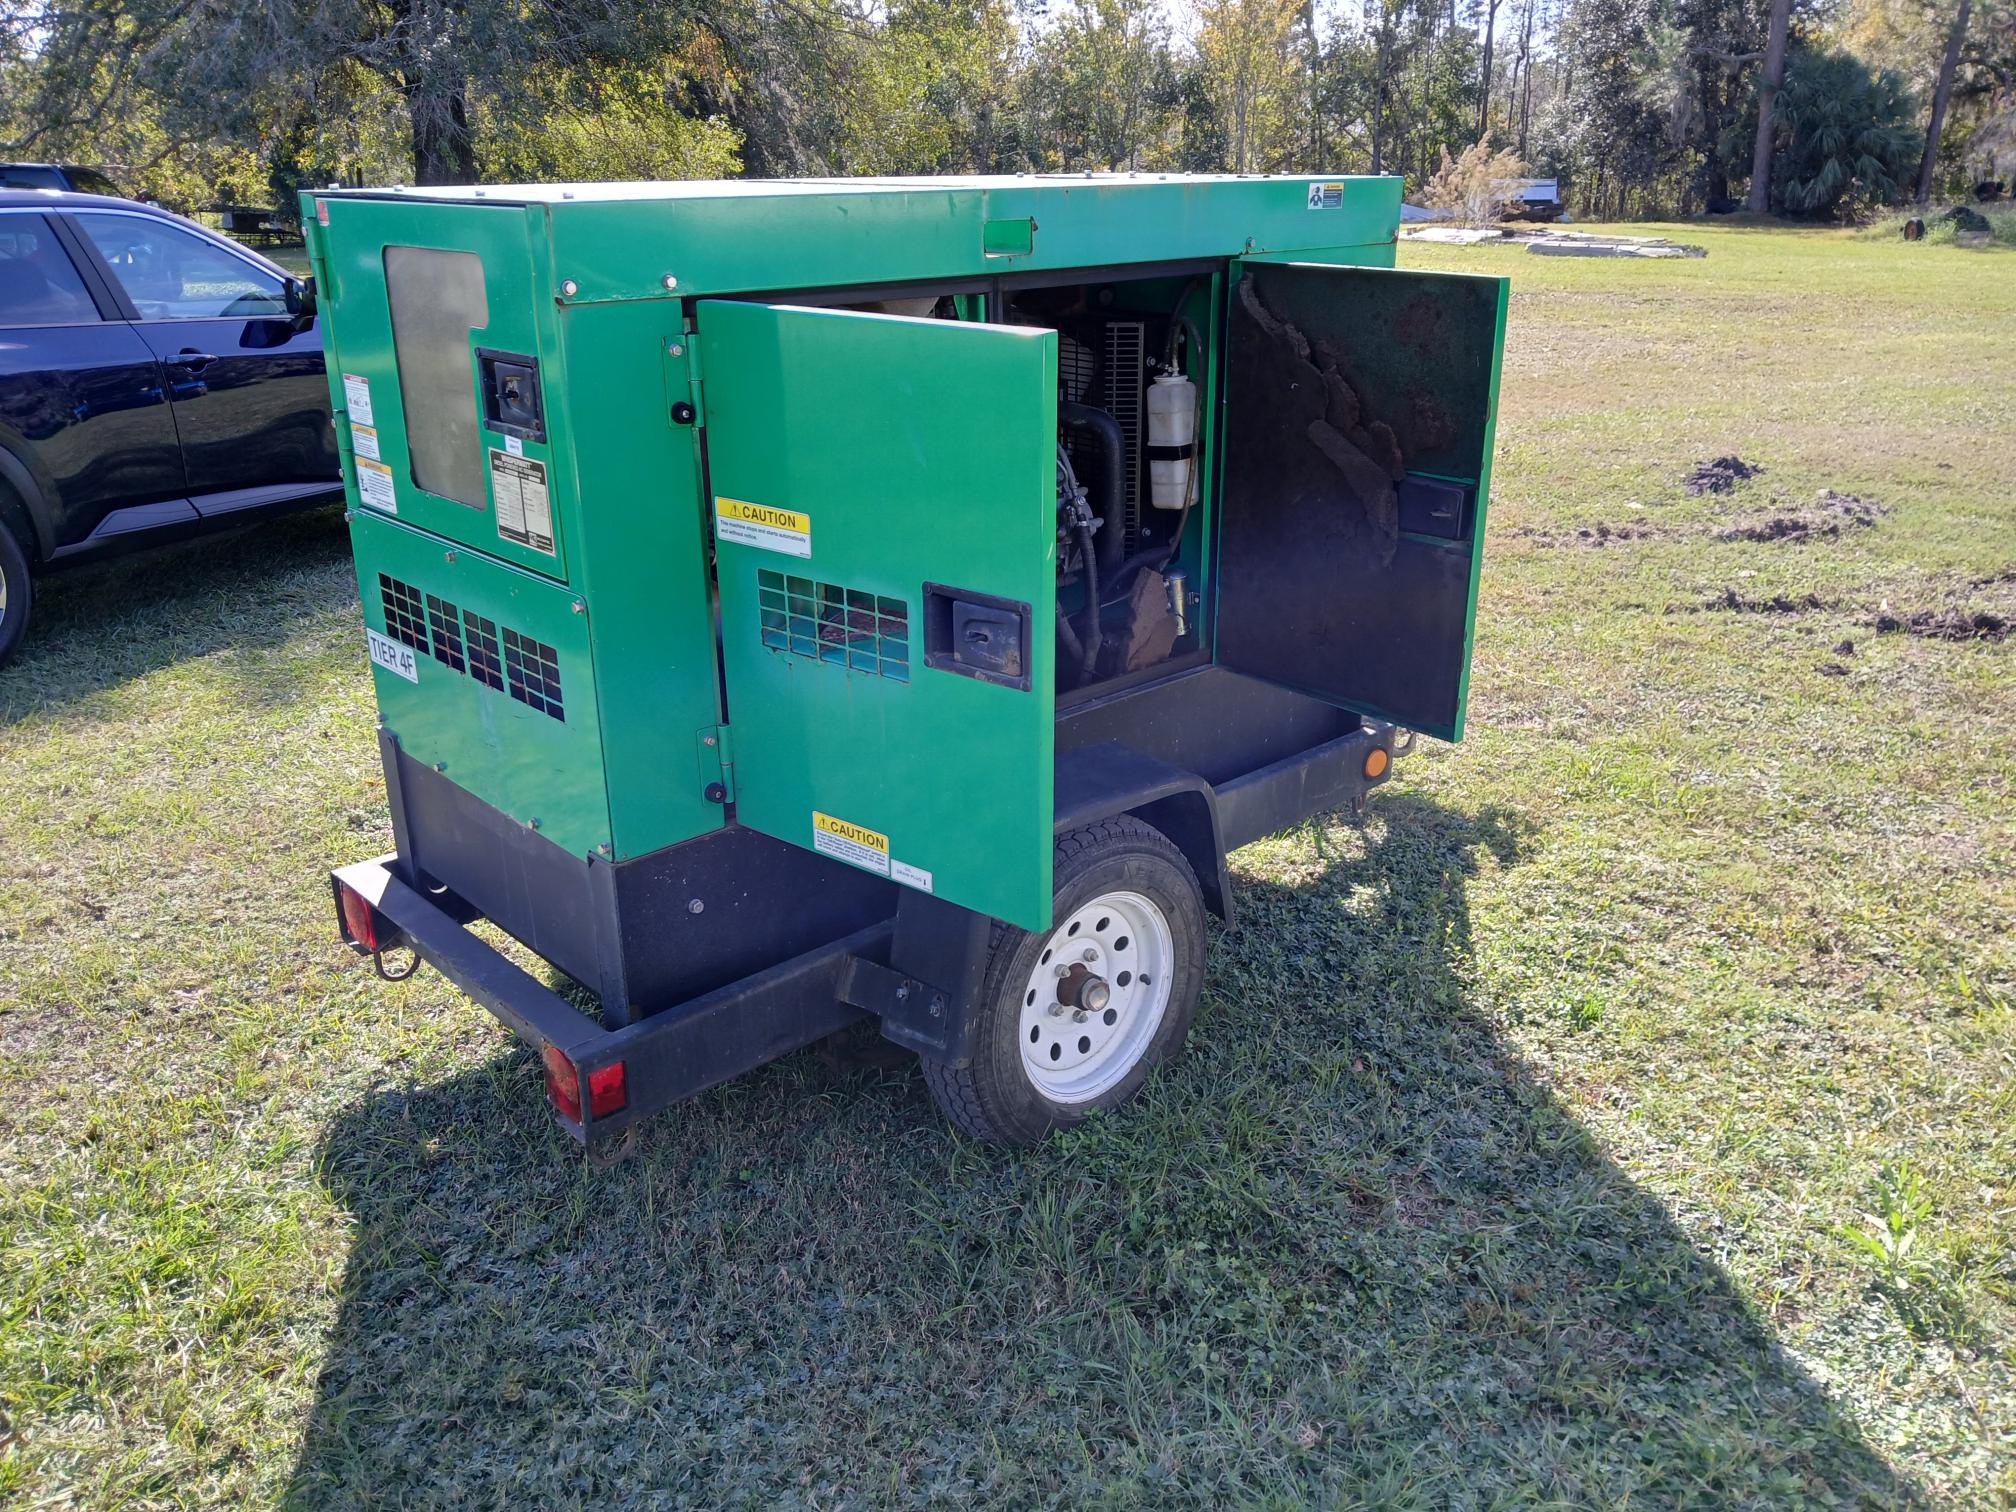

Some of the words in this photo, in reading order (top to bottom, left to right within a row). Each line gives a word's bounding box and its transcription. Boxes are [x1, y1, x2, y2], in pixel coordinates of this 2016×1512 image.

[742, 506, 796, 528] CAUTION
[370, 636, 398, 668] TIER
[400, 651, 413, 675] 4F
[830, 821, 884, 849] CAUTION
